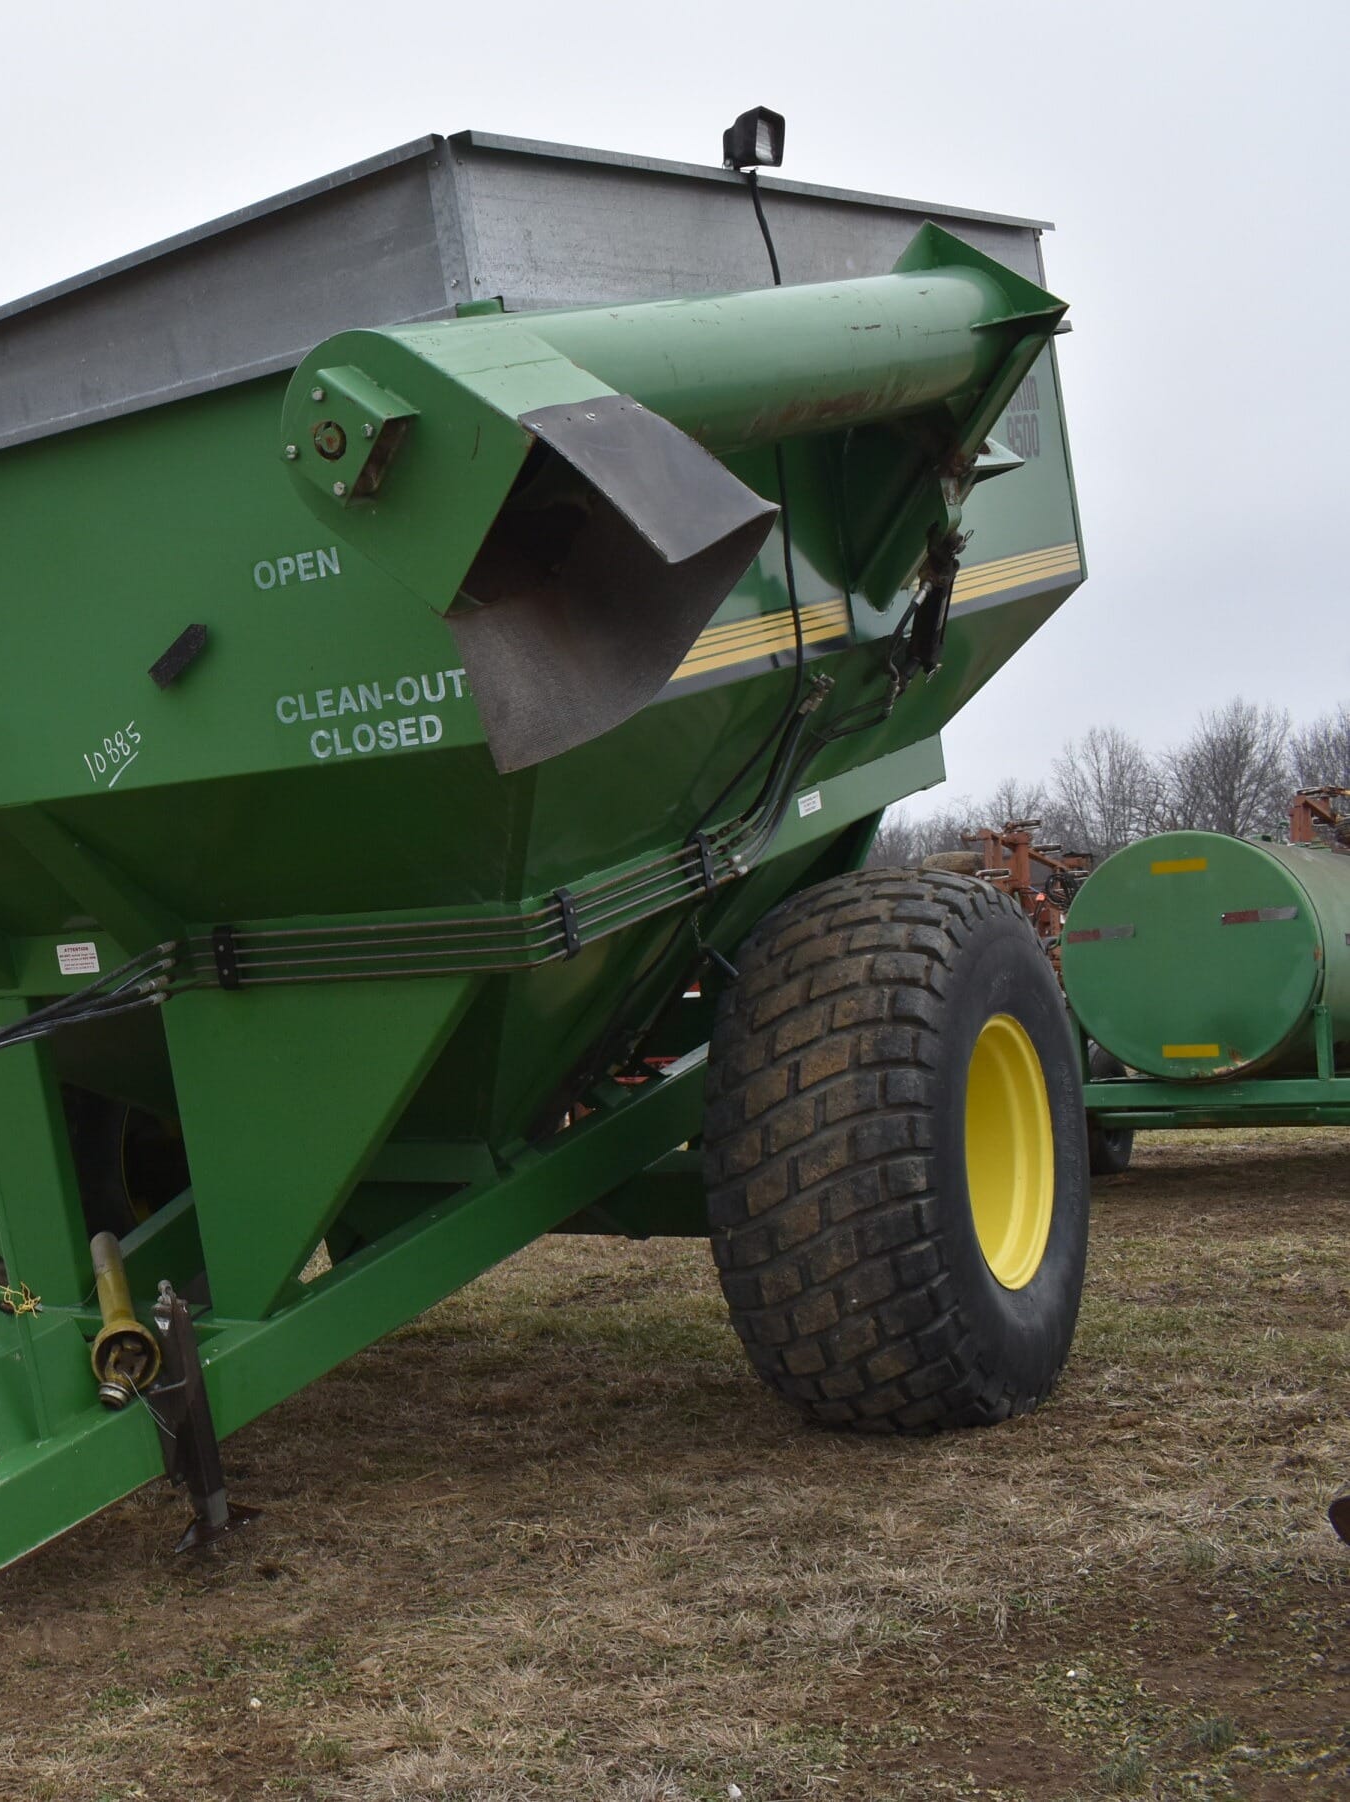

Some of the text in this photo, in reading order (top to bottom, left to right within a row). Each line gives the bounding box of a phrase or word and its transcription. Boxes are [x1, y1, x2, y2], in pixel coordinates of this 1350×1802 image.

[253, 547, 341, 590] OPEN
[275, 668, 467, 724] CLEAN-OUT
[84, 720, 141, 782] 10885
[310, 714, 443, 759] CLOSED
